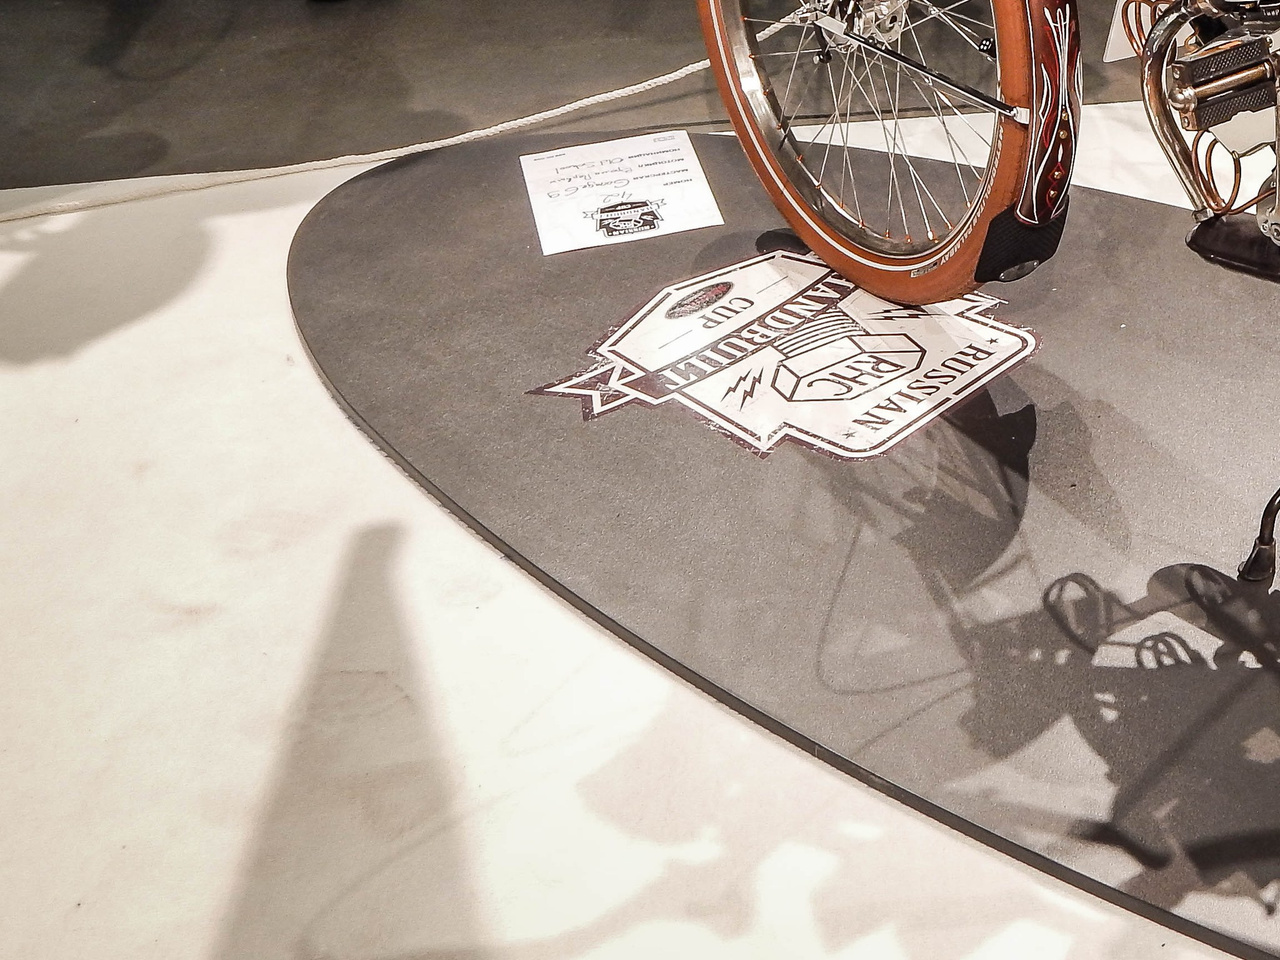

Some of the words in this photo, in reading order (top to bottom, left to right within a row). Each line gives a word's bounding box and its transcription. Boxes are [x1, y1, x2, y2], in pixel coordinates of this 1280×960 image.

[697, 296, 755, 329] CUP
[807, 355, 906, 397] RHC
[852, 343, 998, 434] RUSSIAN
